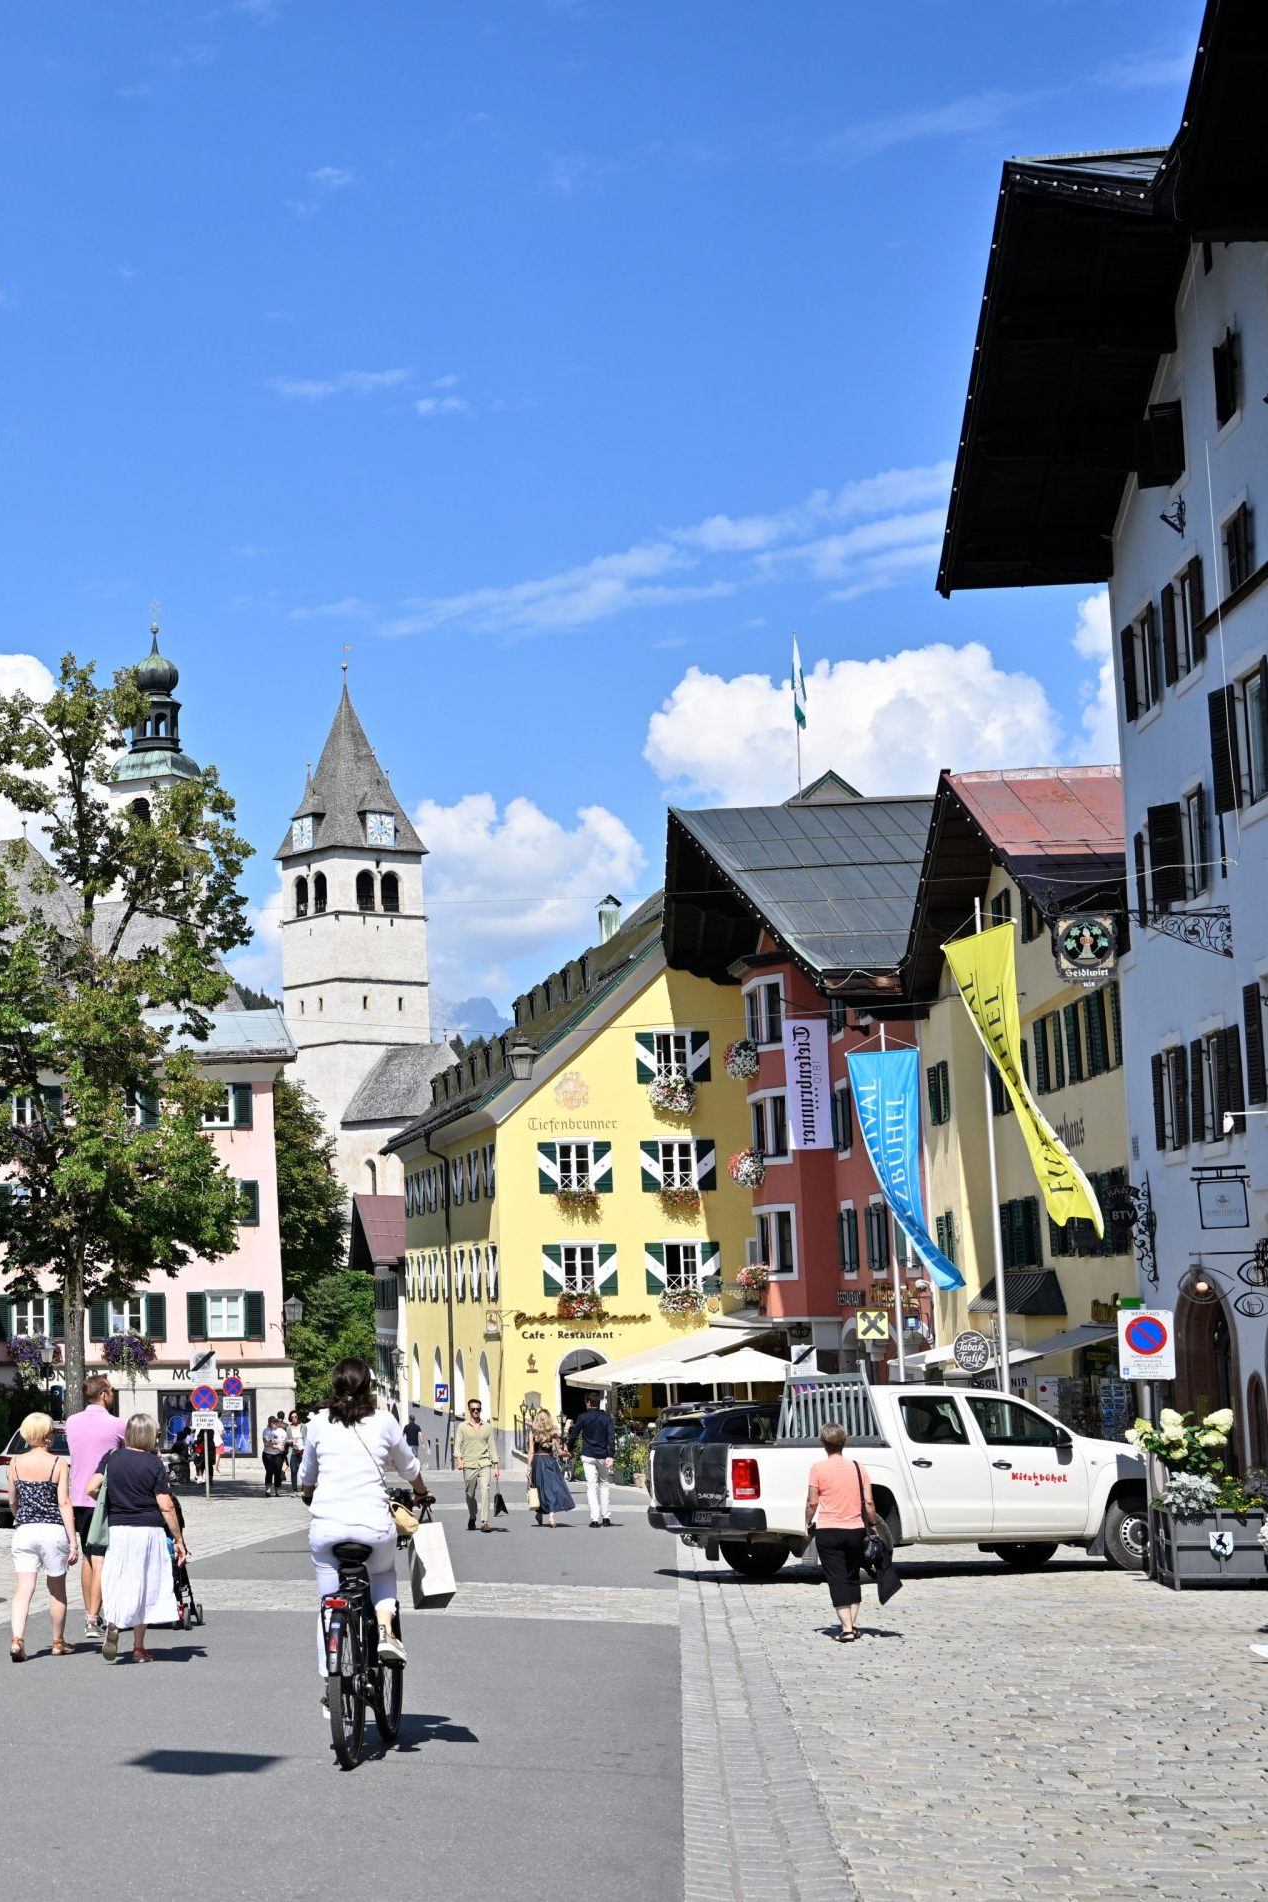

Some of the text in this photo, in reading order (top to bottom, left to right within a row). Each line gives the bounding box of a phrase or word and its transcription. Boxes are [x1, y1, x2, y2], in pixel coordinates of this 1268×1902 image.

[1065, 969, 1108, 977] Seidlwirt
[528, 1117, 618, 1132] Tiefenbrunner
[1112, 1210, 1134, 1221] BTV
[522, 1330, 614, 1340] Cafe Restaurant
[956, 1340, 986, 1352] Tabak
[957, 1351, 986, 1363] Trafik
[1011, 1471, 1068, 1483] Kitzbühel
